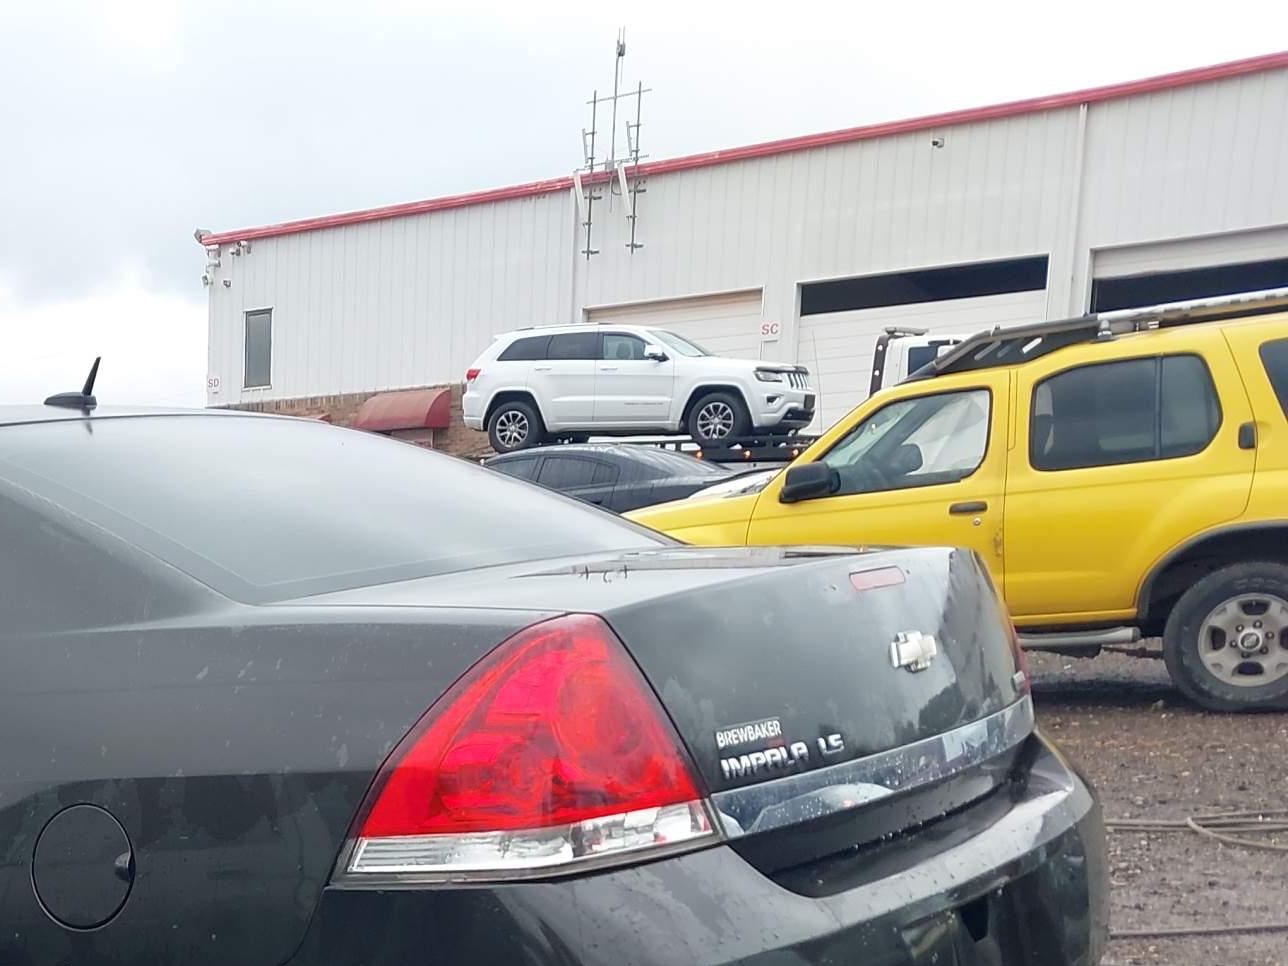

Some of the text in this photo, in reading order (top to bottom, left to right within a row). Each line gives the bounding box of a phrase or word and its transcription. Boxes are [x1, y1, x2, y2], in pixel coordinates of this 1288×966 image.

[762, 323, 779, 335] SC
[208, 378, 220, 388] SD
[715, 720, 782, 750] BREWBAKER
[720, 733, 845, 779] IMPALA LS
